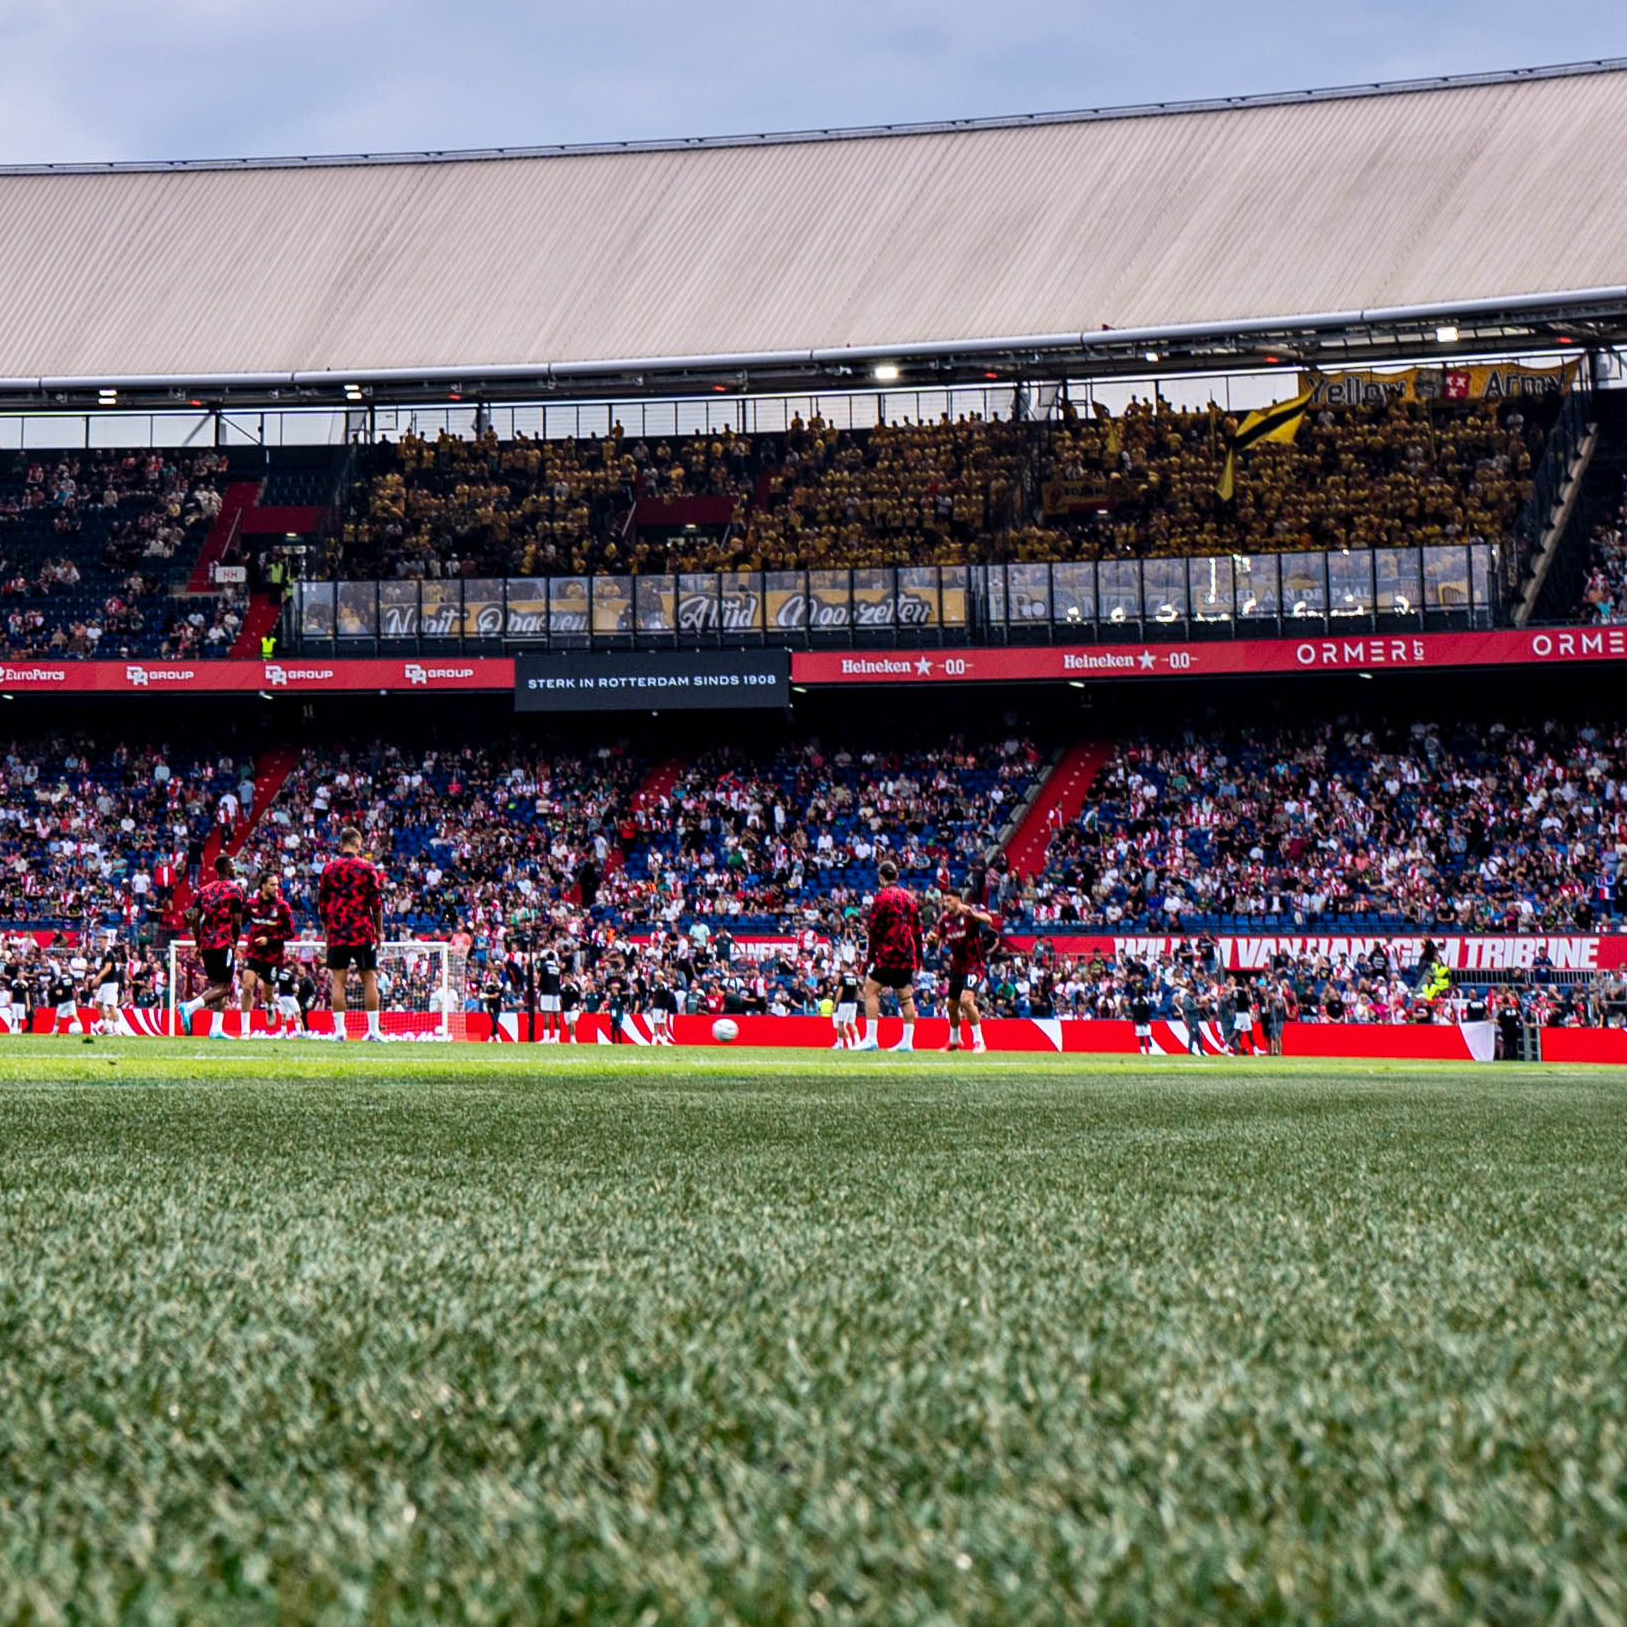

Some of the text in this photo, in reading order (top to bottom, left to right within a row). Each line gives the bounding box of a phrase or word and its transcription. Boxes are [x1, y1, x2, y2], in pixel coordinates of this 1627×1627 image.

[223, 569, 238, 580] HH
[1296, 640, 1407, 665] ORMER
[841, 659, 911, 674] Heineken
[1064, 654, 1134, 669] Heineken
[5, 669, 65, 681] EuroParcs
[149, 670, 194, 680] GROUP
[288, 669, 334, 679] GROUP
[427, 668, 474, 678] GROUP
[528, 674, 776, 689] STERK IN ROTTERDAM SINDS 1908
